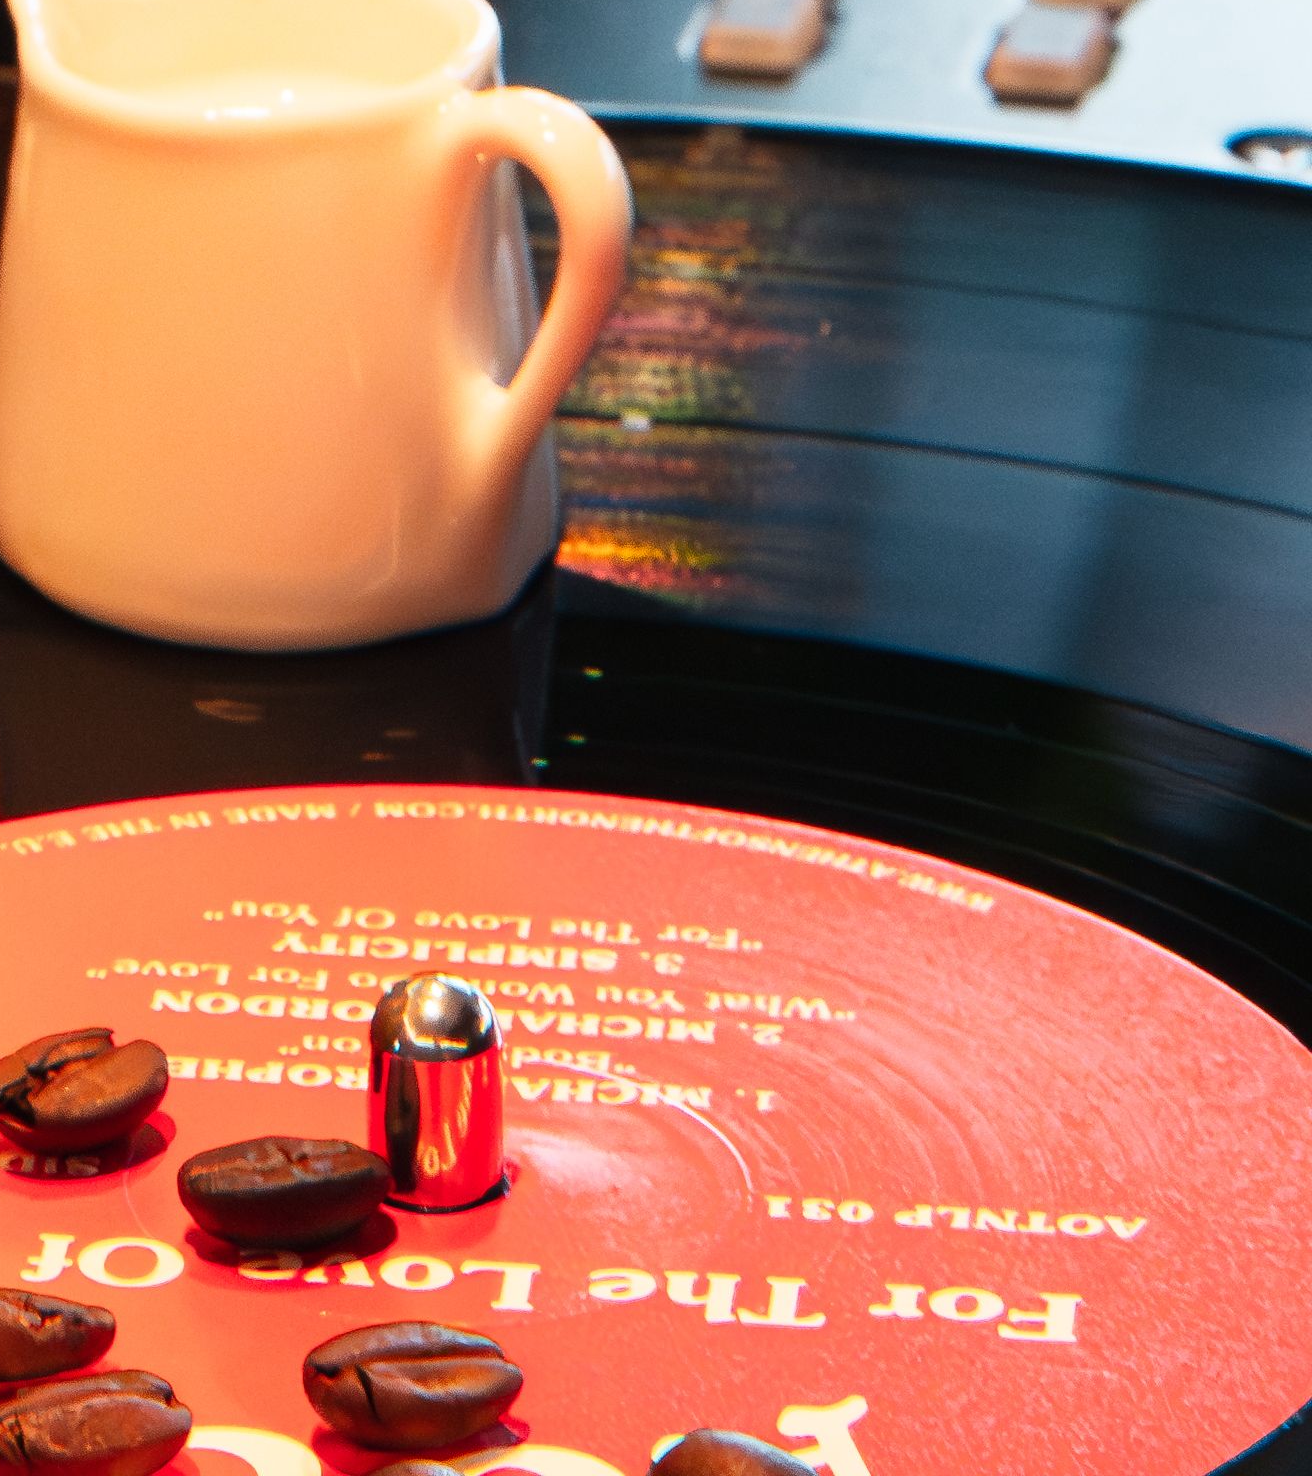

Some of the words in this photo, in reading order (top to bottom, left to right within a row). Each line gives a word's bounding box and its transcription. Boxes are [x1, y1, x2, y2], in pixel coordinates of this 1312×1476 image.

[169, 809, 213, 829] IN
[223, 802, 336, 825] MADE
[0, 829, 76, 856] E.U.
[81, 818, 162, 843] THE
[334, 906, 396, 930] Of
[413, 911, 531, 939] Love
[552, 917, 640, 946] The
[272, 931, 618, 972] SIMPLICITY
[658, 923, 763, 953] "For
[86, 957, 231, 986] Love"
[641, 951, 685, 975] 3.
[248, 965, 328, 991] For
[150, 989, 376, 1022] ORDON
[597, 984, 684, 1013] You
[706, 991, 856, 1022] "What
[739, 1022, 784, 1047] 2.
[503, 1045, 636, 1075] "Bod
[737, 1087, 777, 1112] 1.
[766, 1195, 874, 1225] 031
[895, 1203, 1147, 1240] AOTNLP
[21, 1233, 185, 1288] Of
[239, 1248, 541, 1313] Love
[588, 1267, 826, 1328] The
[868, 1282, 1083, 1344] For
